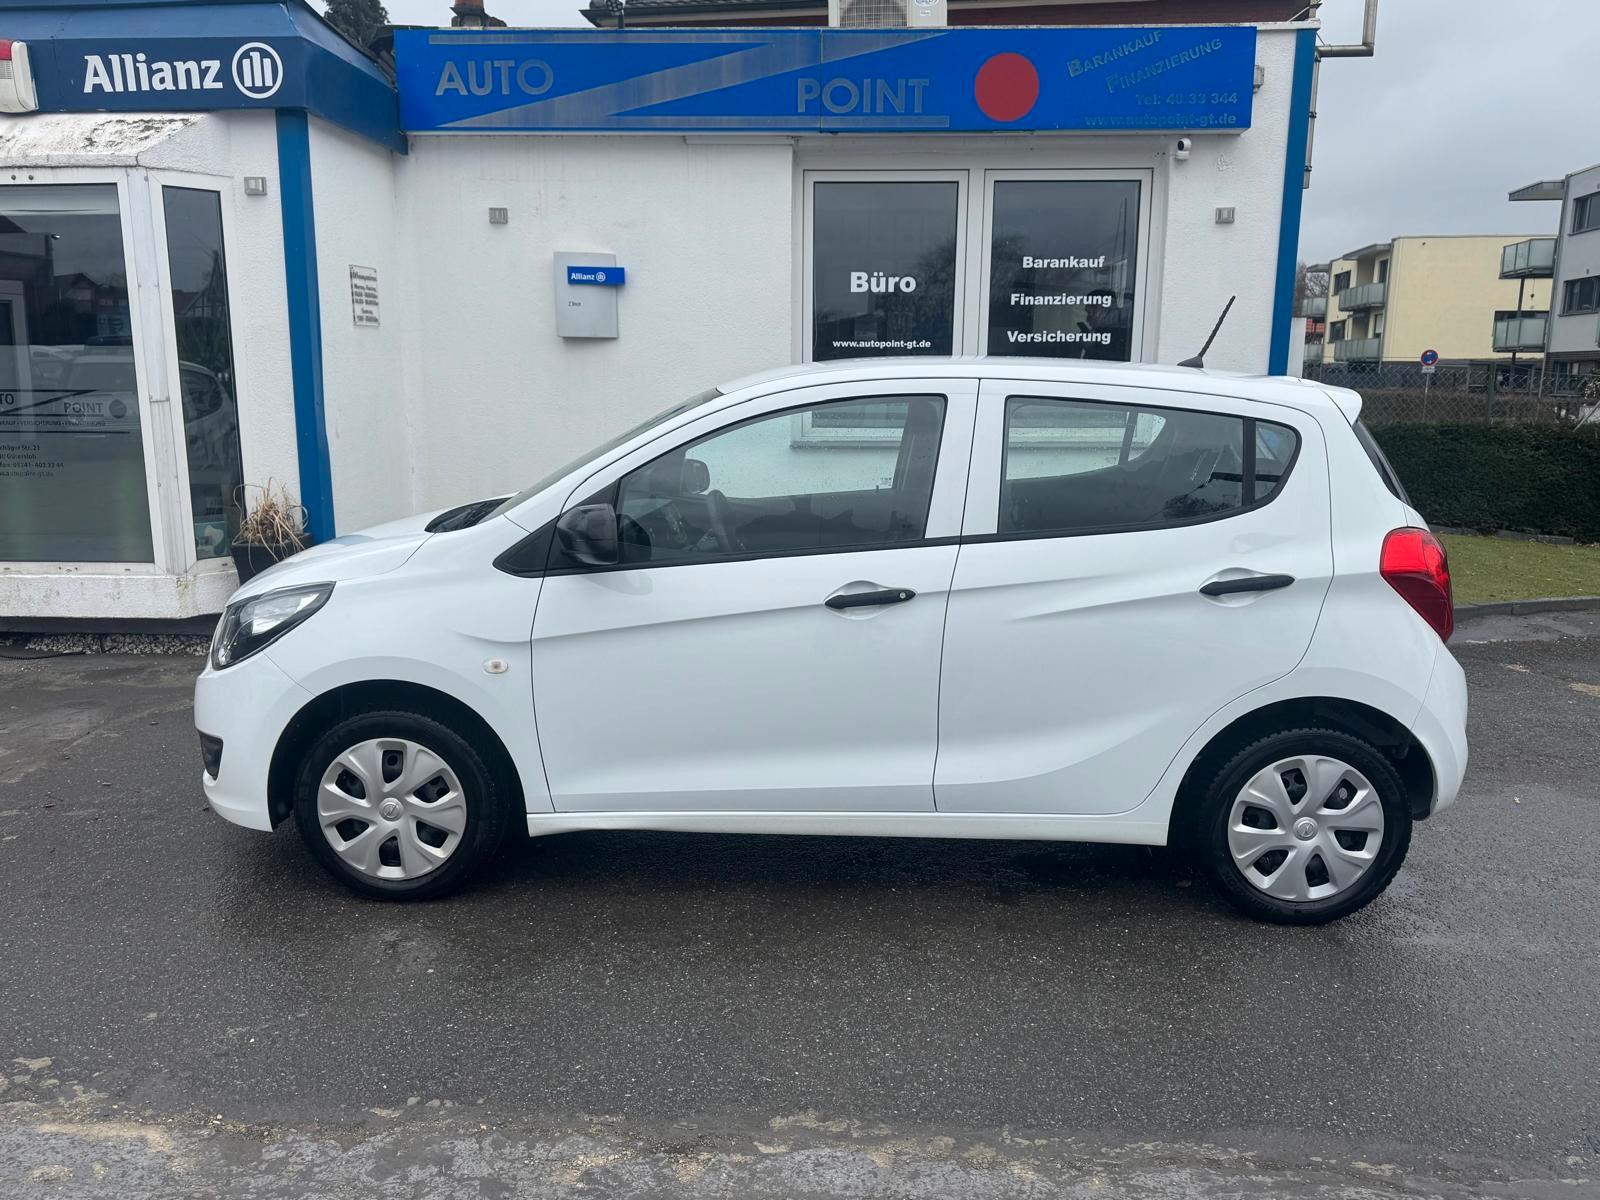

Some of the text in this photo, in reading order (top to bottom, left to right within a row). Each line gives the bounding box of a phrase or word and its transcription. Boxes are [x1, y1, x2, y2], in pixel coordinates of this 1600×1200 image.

[1067, 30, 1163, 78] BARANKAUF
[83, 52, 224, 94] Allianz
[1106, 38, 1223, 94] FINANZIERUNG
[435, 58, 554, 97] AUTO
[797, 77, 930, 114] POINT
[1165, 93, 1185, 105] 40
[1210, 92, 1239, 105] 344
[1085, 112, 1238, 127] www.autopoint-gt.de
[1022, 255, 1106, 269] Barankauf
[570, 272, 596, 281] Allianz
[850, 271, 917, 294] Büro
[1010, 293, 1113, 308] Finanzierung
[832, 339, 932, 350] www.autopoint-gt.de
[1006, 330, 1112, 345] Versicherung
[63, 402, 104, 414] POINT
